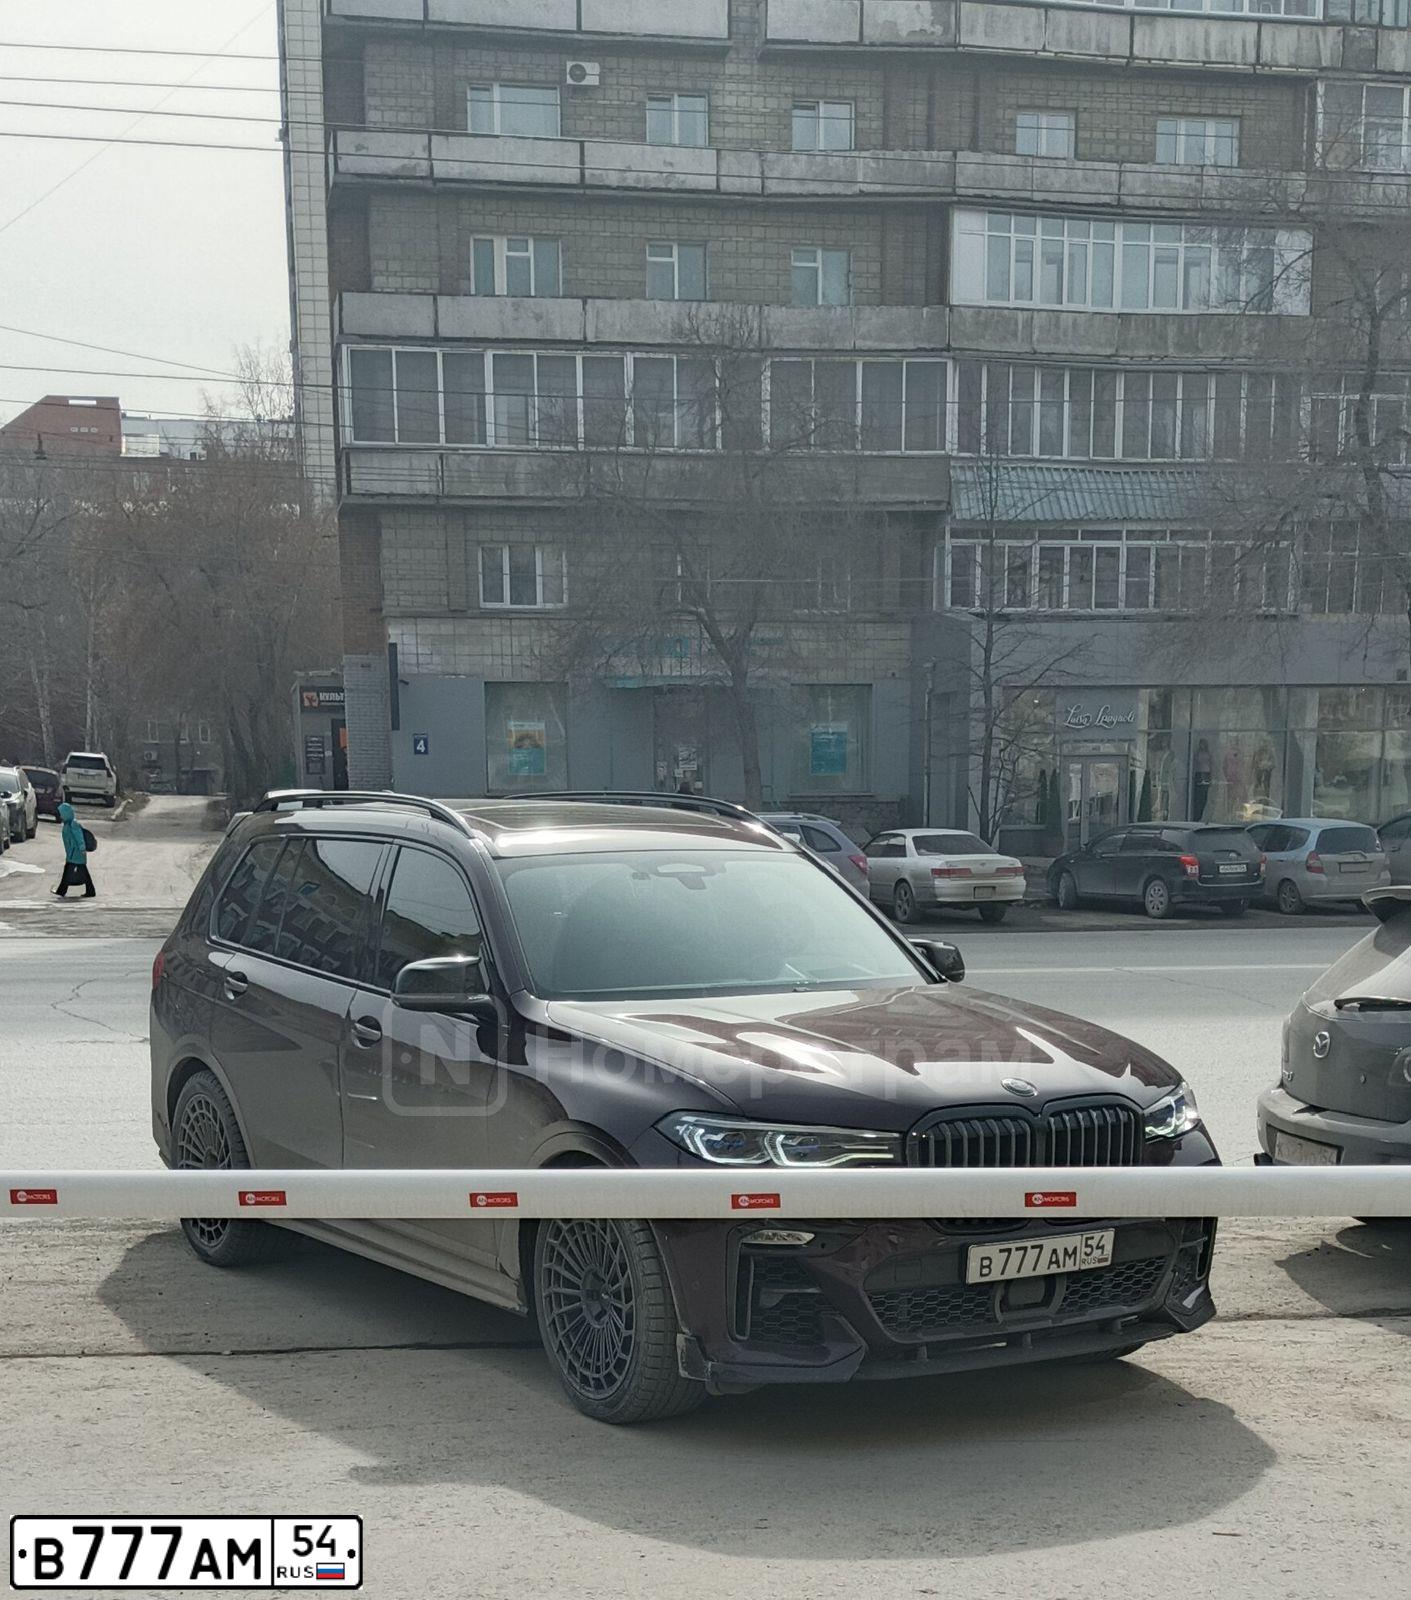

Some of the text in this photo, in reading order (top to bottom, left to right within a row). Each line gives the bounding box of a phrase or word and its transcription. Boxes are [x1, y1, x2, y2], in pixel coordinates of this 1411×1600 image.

[416, 739, 426, 753] 4
[1084, 1234, 1106, 1257] 54
[1081, 1256, 1097, 1265] RUS
